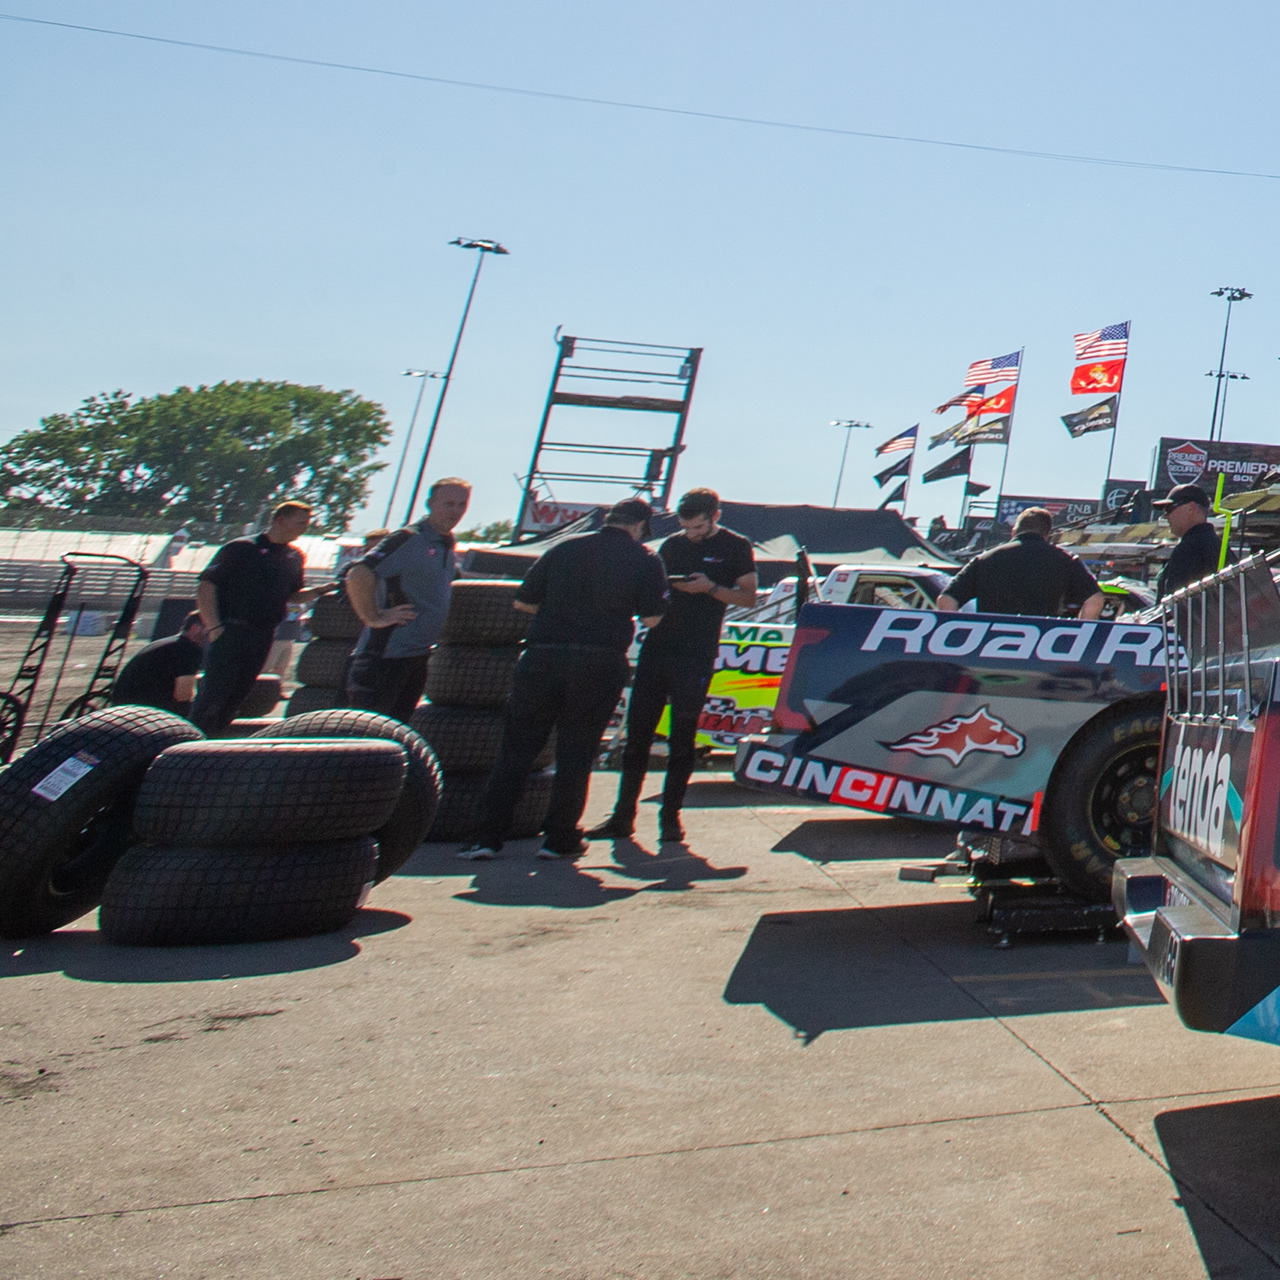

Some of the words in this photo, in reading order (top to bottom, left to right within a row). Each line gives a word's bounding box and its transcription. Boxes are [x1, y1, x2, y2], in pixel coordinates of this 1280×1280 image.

[1208, 460, 1268, 474] PREMIER
[860, 609, 1098, 664] Road
[745, 749, 1033, 837] CINCINNATI
[1170, 723, 1232, 858] tenda
